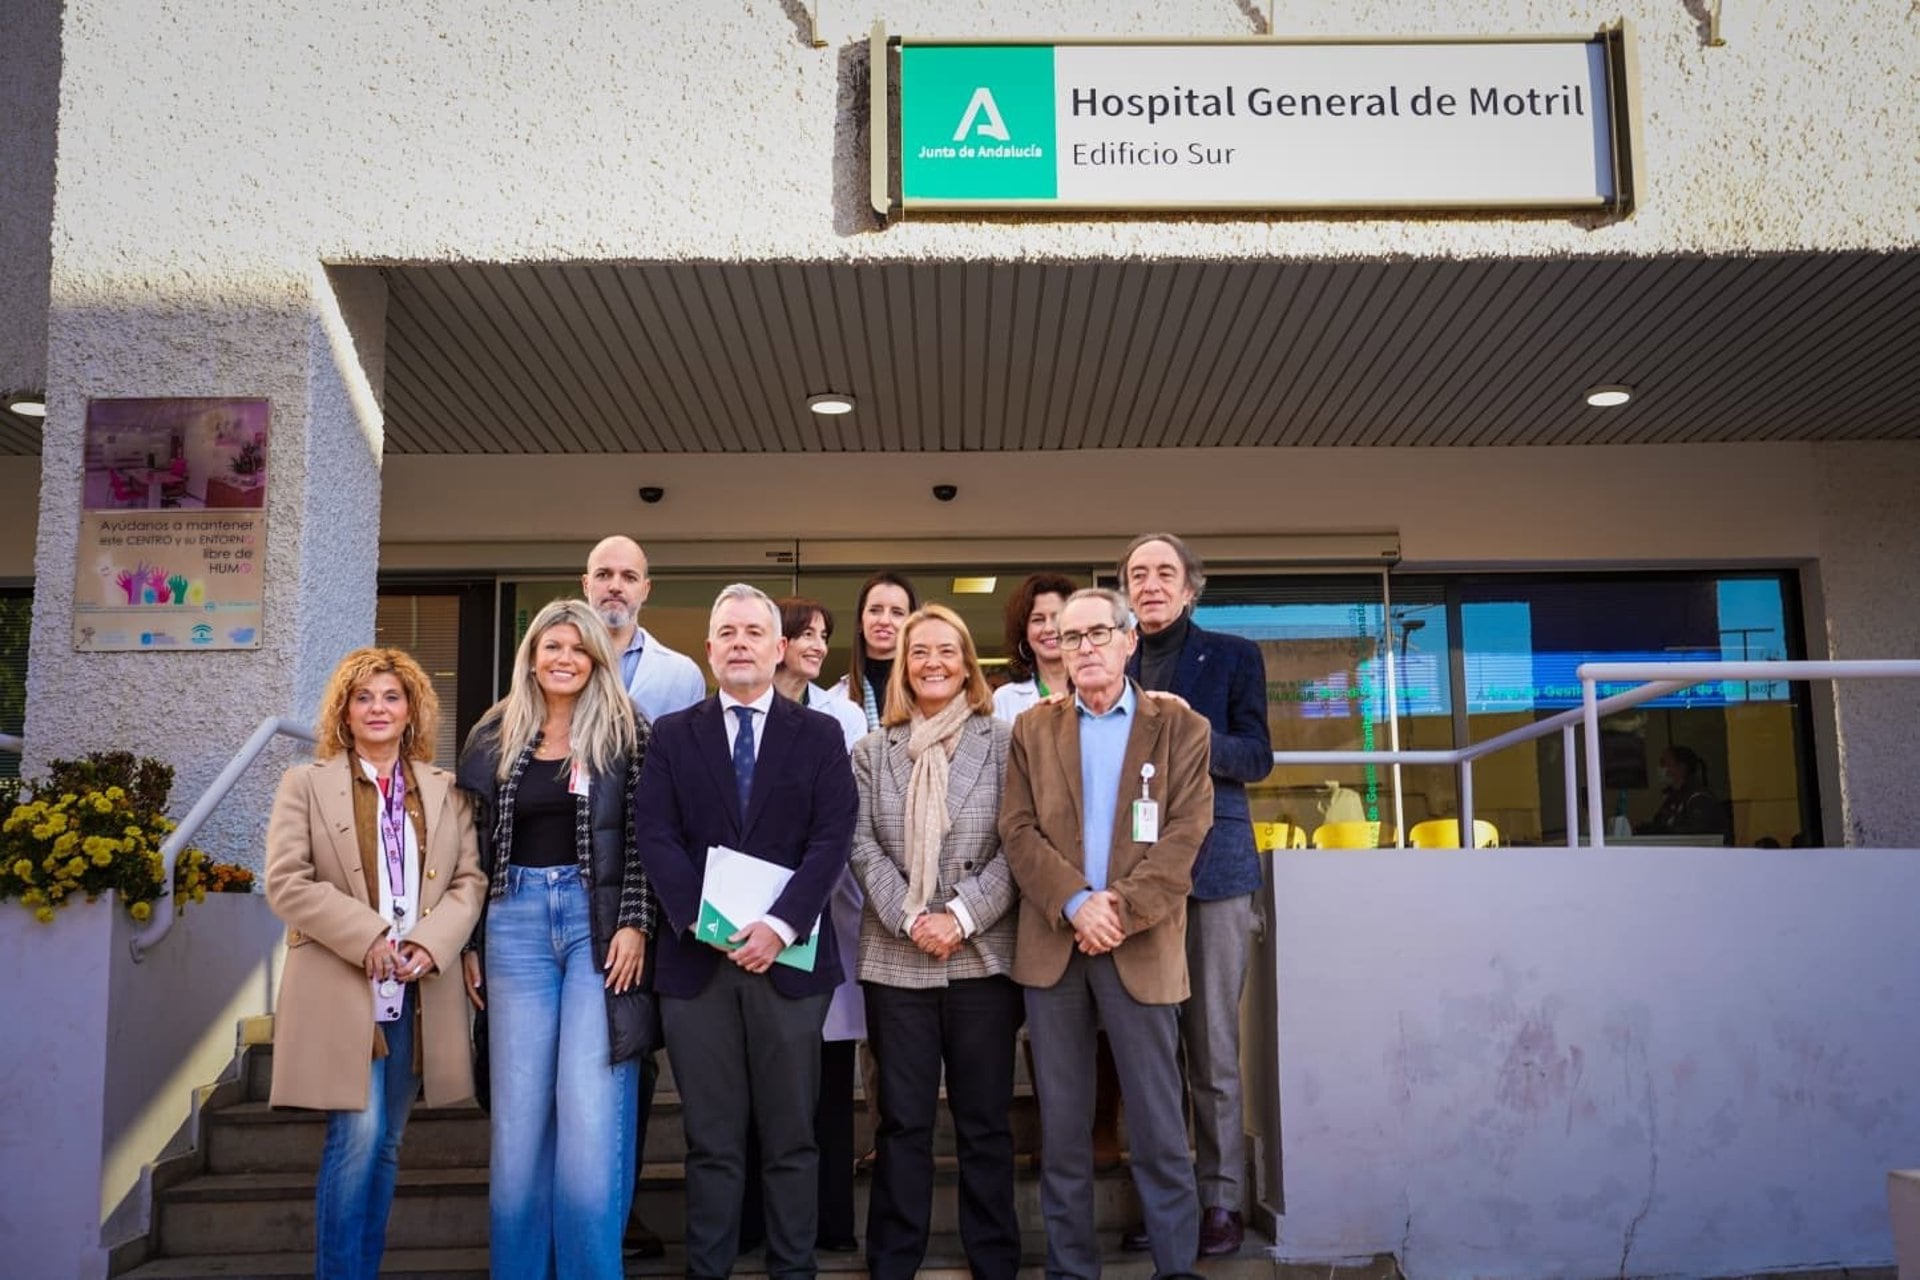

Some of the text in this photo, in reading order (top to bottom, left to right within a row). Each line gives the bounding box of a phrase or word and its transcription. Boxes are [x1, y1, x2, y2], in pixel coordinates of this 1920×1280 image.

[1072, 85, 1585, 124] Hospital General de Motril
[918, 144, 1043, 158] Junta de Andalucía
[1073, 142, 1236, 165] Edificio Sur
[101, 520, 254, 534] Ayúdanos a mantener
[100, 536, 123, 546] este
[126, 536, 173, 545] CENTRO
[175, 537, 182, 546] y
[184, 536, 196, 545] su
[203, 548, 253, 559] libre de
